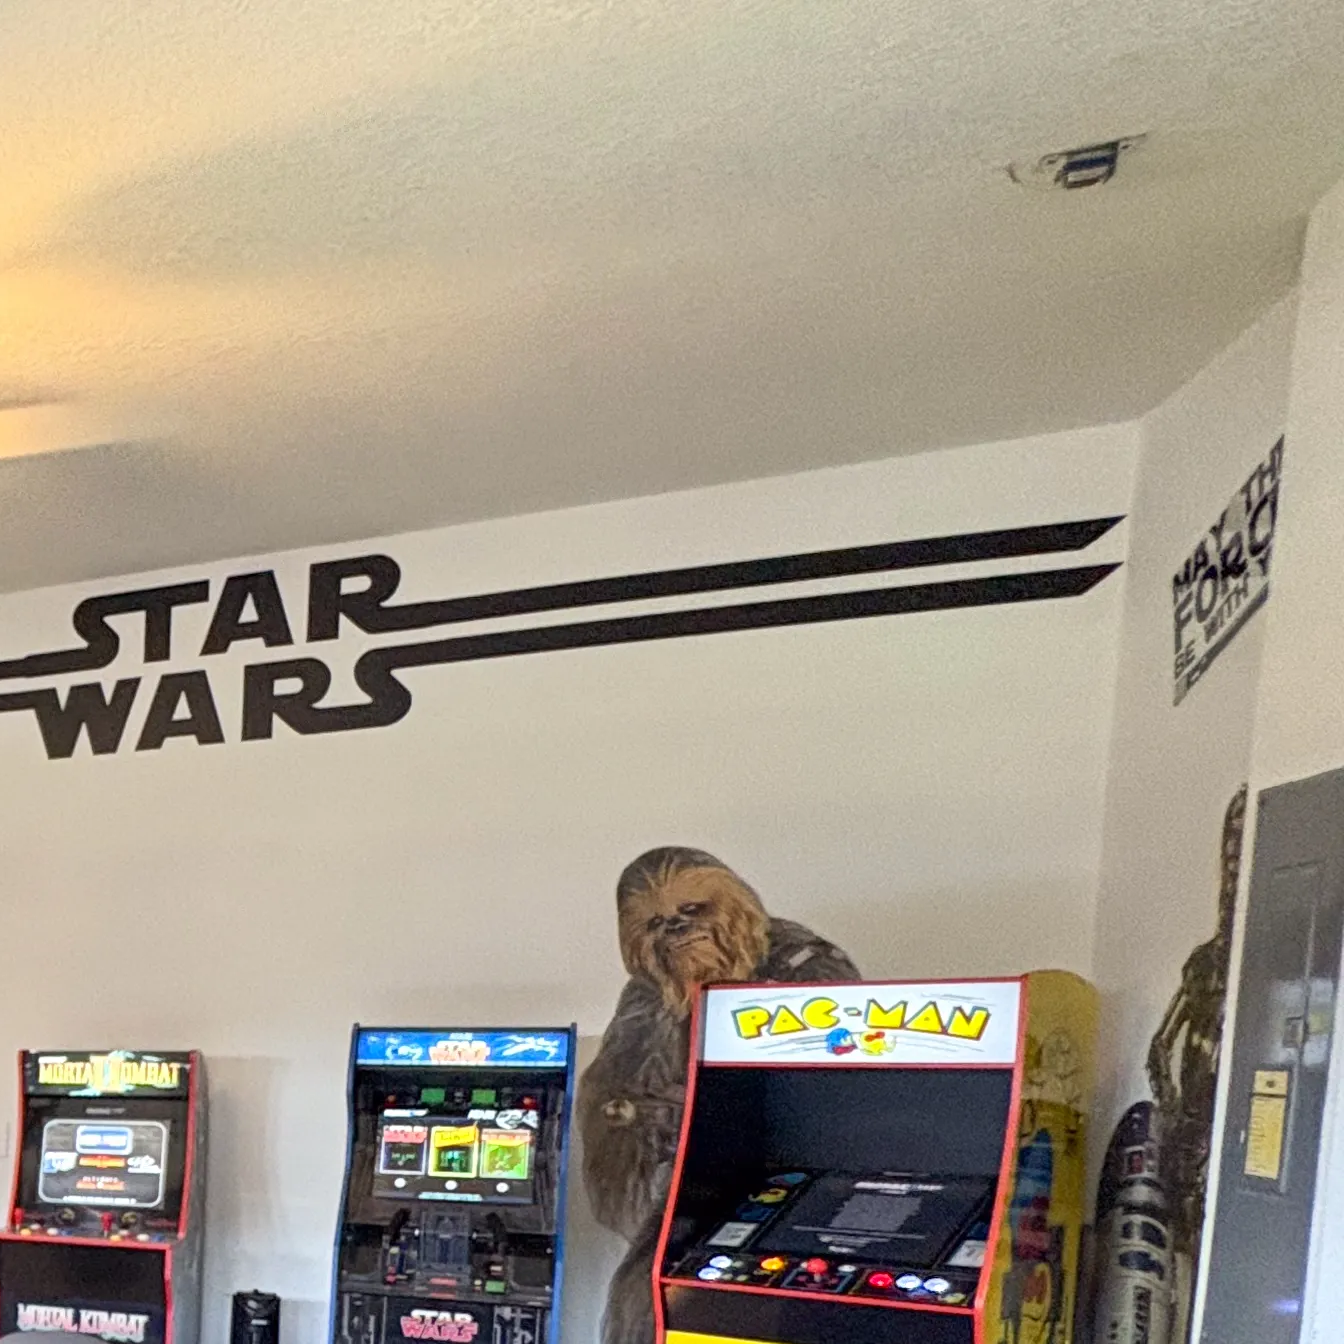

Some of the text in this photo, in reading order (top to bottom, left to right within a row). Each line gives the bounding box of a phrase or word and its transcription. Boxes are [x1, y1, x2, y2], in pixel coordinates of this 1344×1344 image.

[1239, 433, 1285, 516] TH
[72, 553, 402, 670] STAR
[33, 645, 413, 760] WARS
[731, 996, 991, 1041] PAC-MAN
[400, 1316, 479, 1343] WARS
[410, 1309, 473, 1324] STAR
